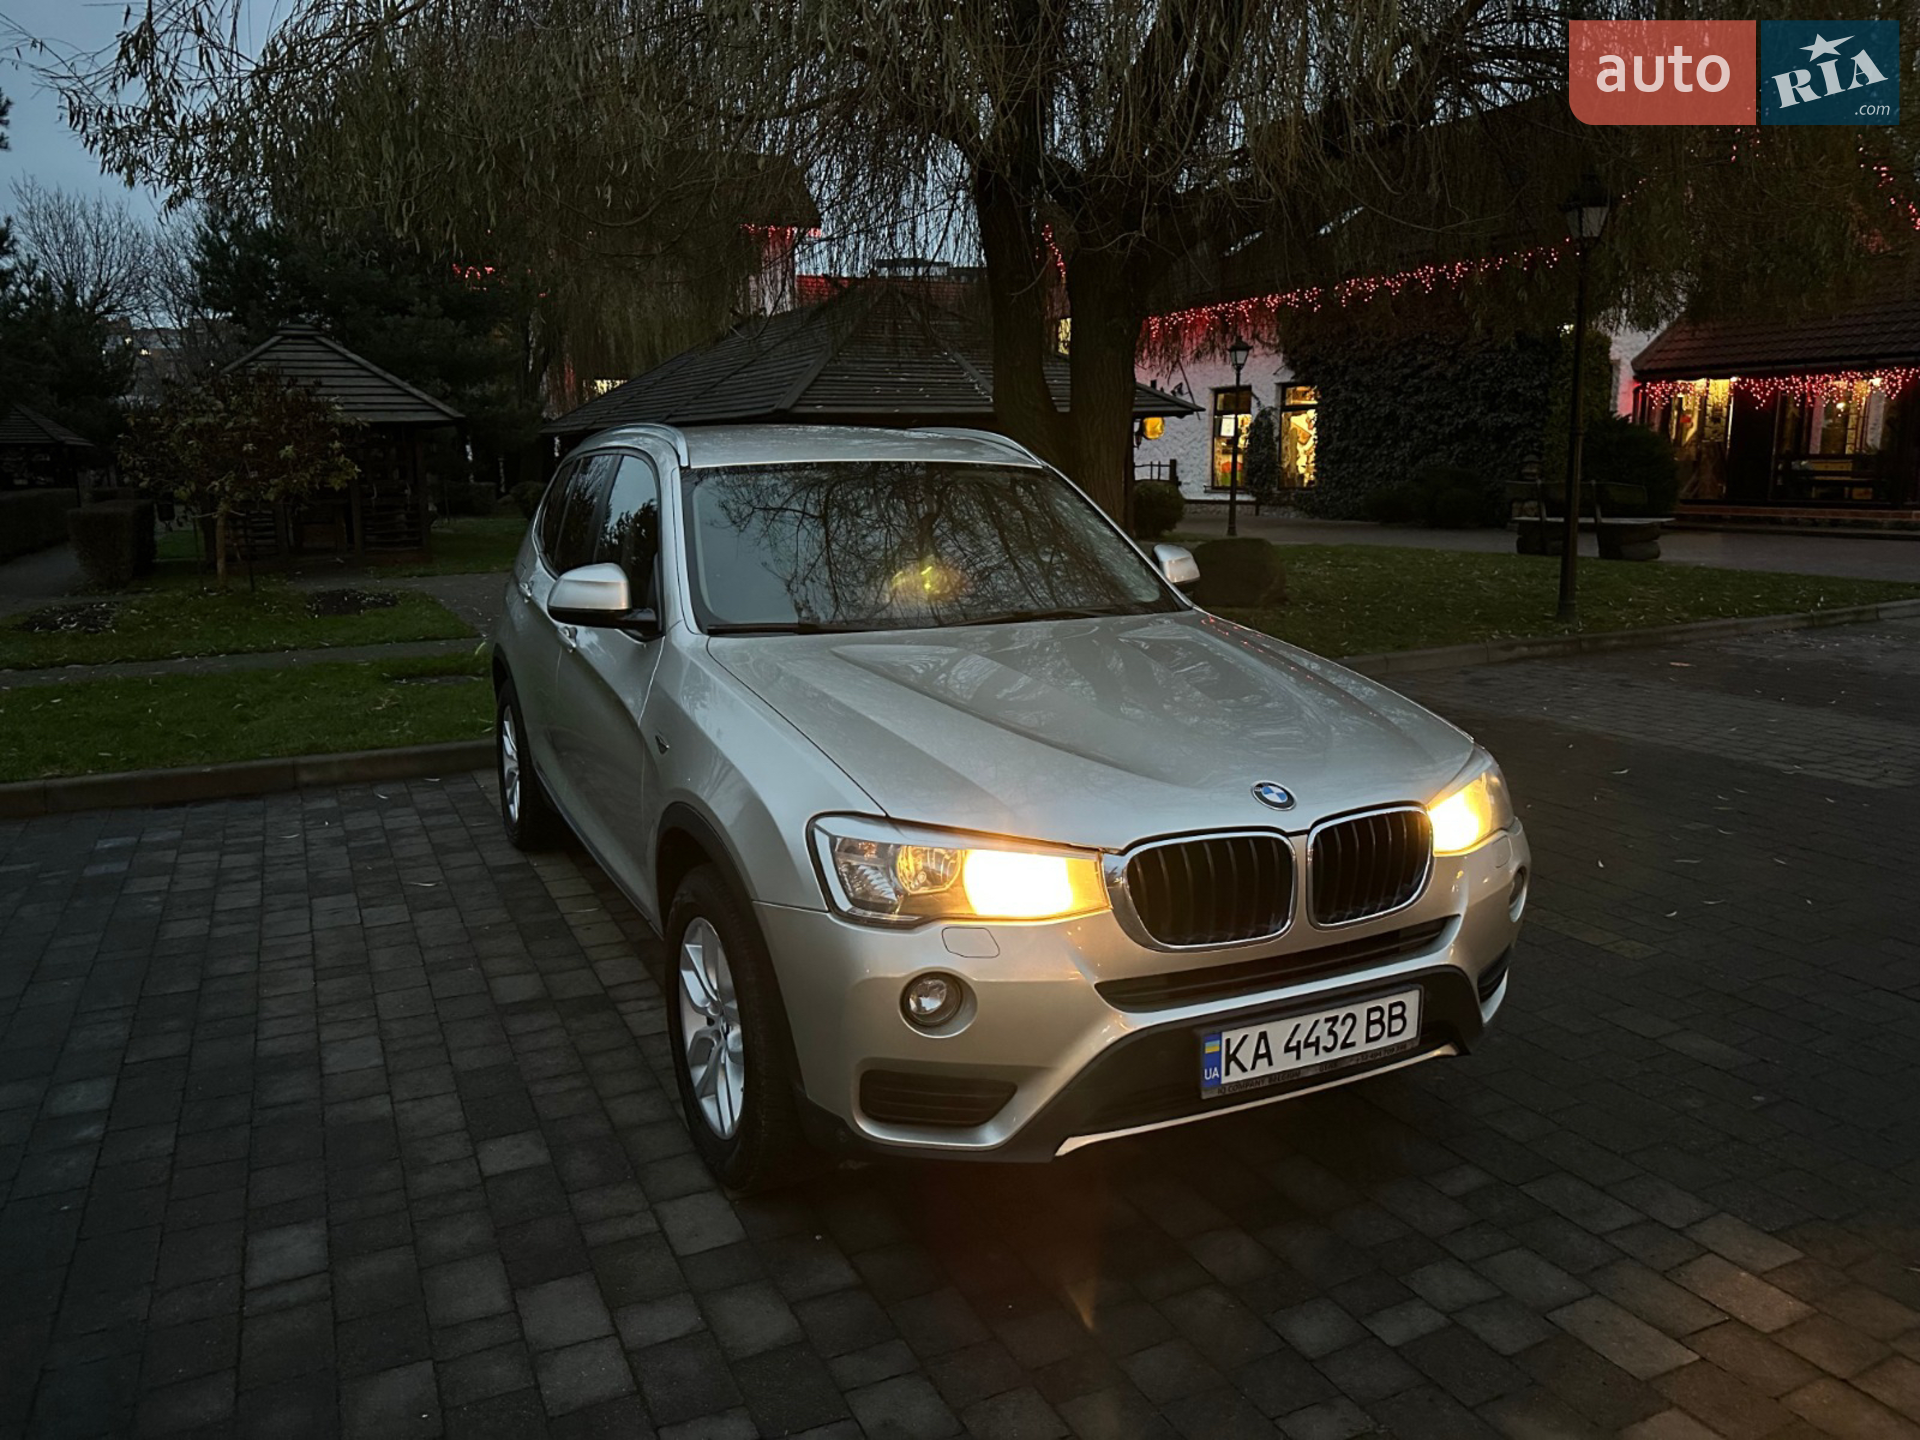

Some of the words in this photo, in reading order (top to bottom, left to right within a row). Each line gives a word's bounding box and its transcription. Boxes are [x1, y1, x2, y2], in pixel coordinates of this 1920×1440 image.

[1224, 1030, 1274, 1077] KA
[1283, 1012, 1357, 1061] 4432
[1365, 1000, 1407, 1044] BB
[1204, 1066, 1220, 1080] UA
